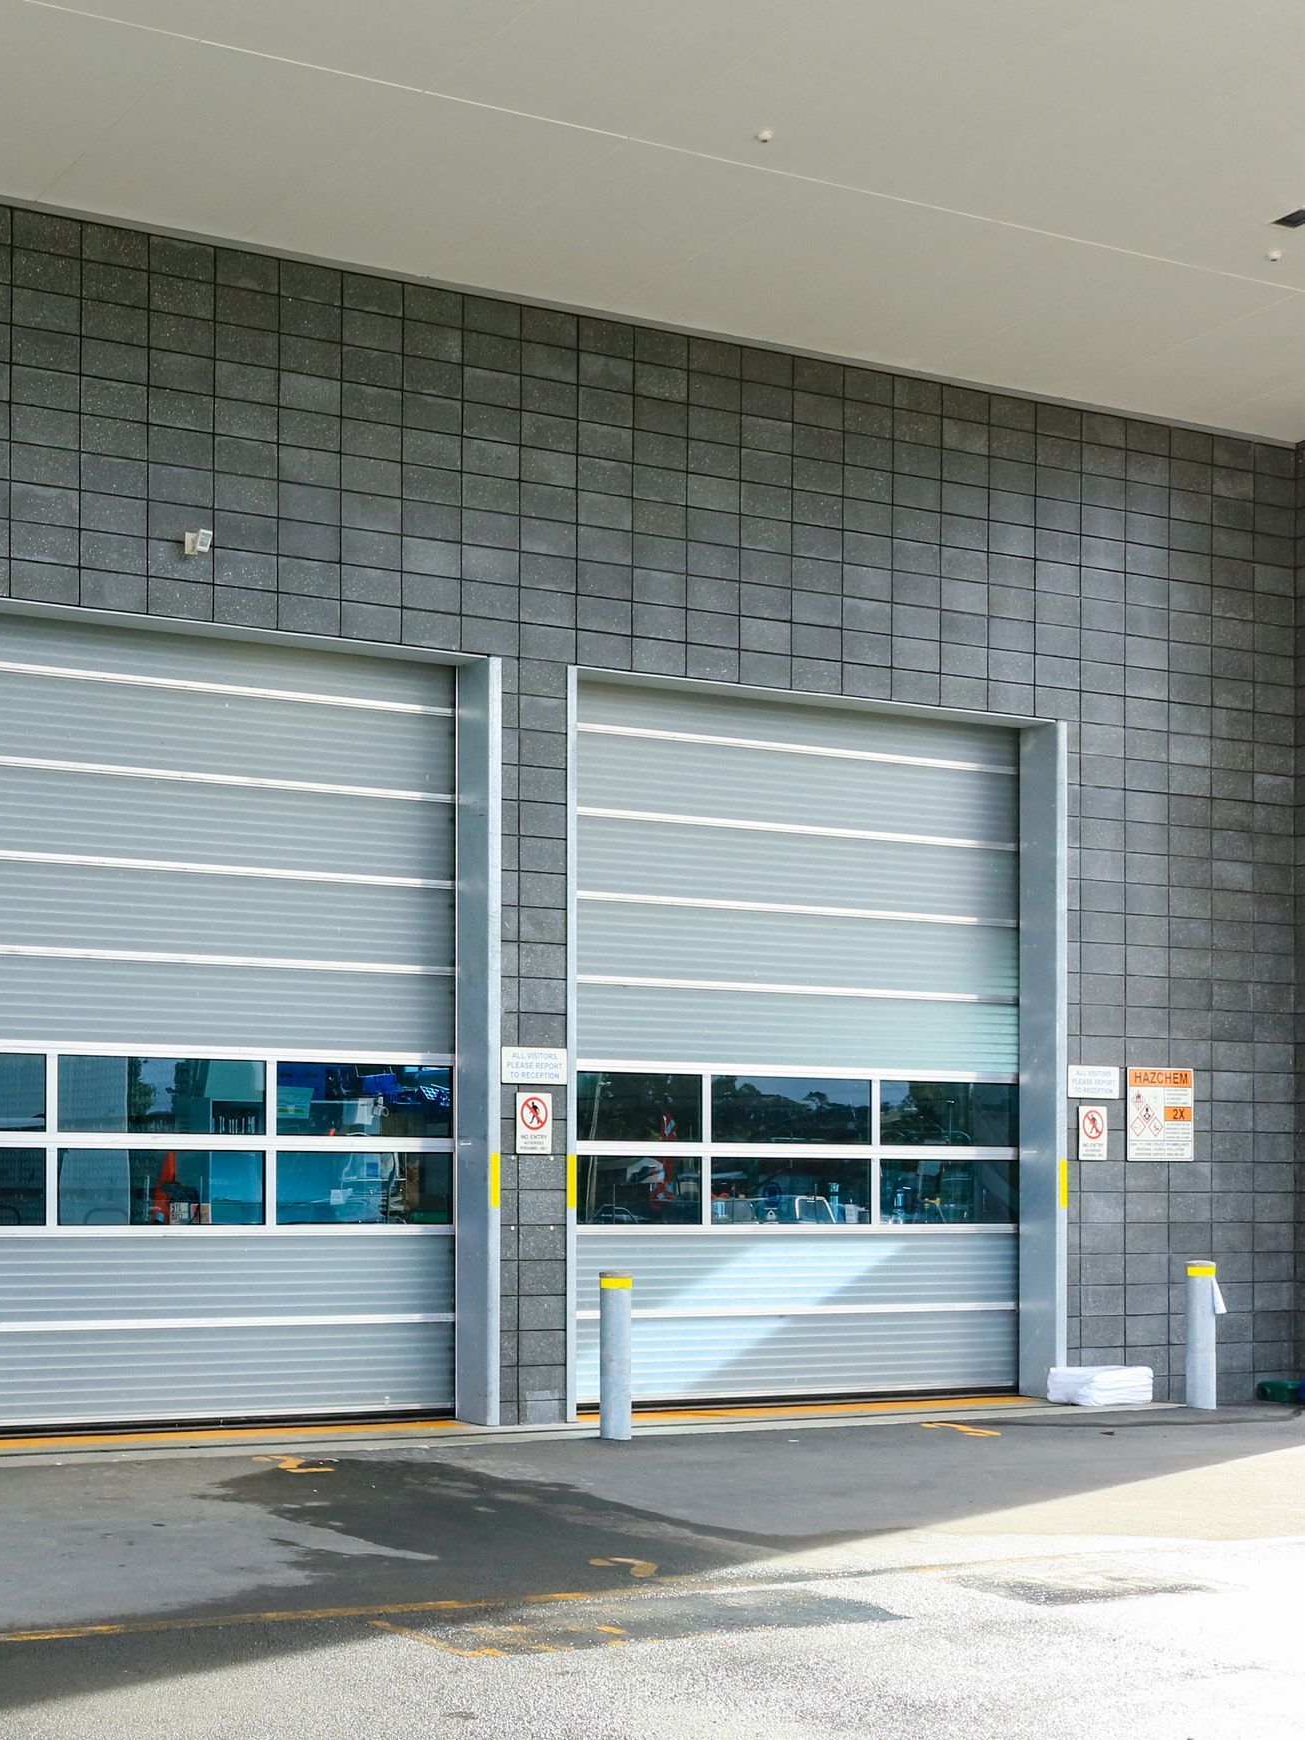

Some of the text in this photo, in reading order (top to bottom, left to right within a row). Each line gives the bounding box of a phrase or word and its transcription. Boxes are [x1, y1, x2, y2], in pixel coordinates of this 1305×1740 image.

[527, 1052, 558, 1060] VISITORS
[535, 1062, 562, 1070] REPORT
[1134, 1072, 1188, 1084] HAZCHEM
[1172, 1108, 1185, 1120] 2X
